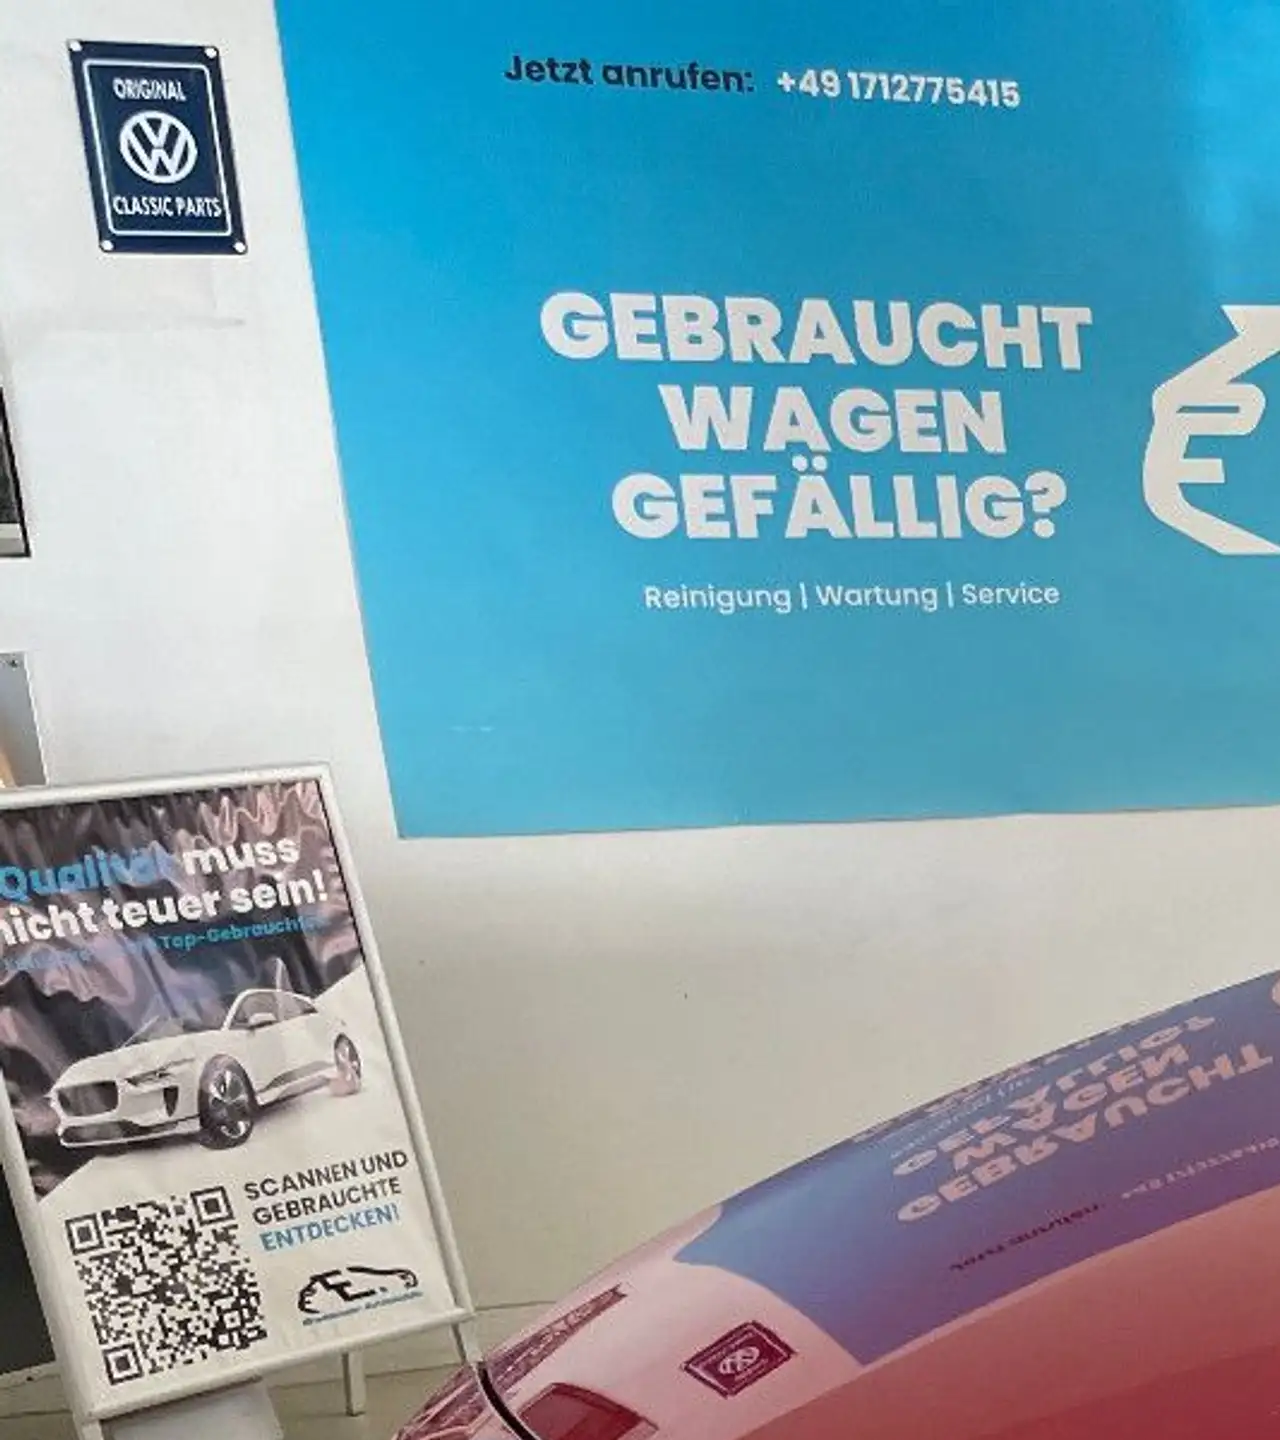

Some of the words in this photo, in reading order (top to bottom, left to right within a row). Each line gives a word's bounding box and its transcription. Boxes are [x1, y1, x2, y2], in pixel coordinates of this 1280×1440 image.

[112, 77, 187, 101] ORIGINAL
[504, 55, 594, 85] Jetzt
[602, 60, 755, 93] anrufen:
[777, 69, 839, 97] +49
[848, 71, 1021, 108] 1712775415
[113, 196, 174, 216] CLASSIC
[175, 197, 223, 218] PARTS
[540, 291, 1093, 371] GEBRAUCHT
[658, 384, 1007, 453] WAGEN
[611, 455, 1067, 539] GEFÄLLIG?
[644, 583, 792, 615] Reinigung
[815, 581, 938, 612] Wartung
[961, 583, 1061, 605] Service
[182, 837, 299, 875] muss
[102, 889, 221, 930] teuer
[230, 868, 328, 913] sein!
[244, 1159, 358, 1201] SCANNEN
[361, 1150, 408, 1175] UND
[252, 1176, 402, 1225] GEBRAUCHTE
[260, 1203, 400, 1251] ENTDECKEN!
